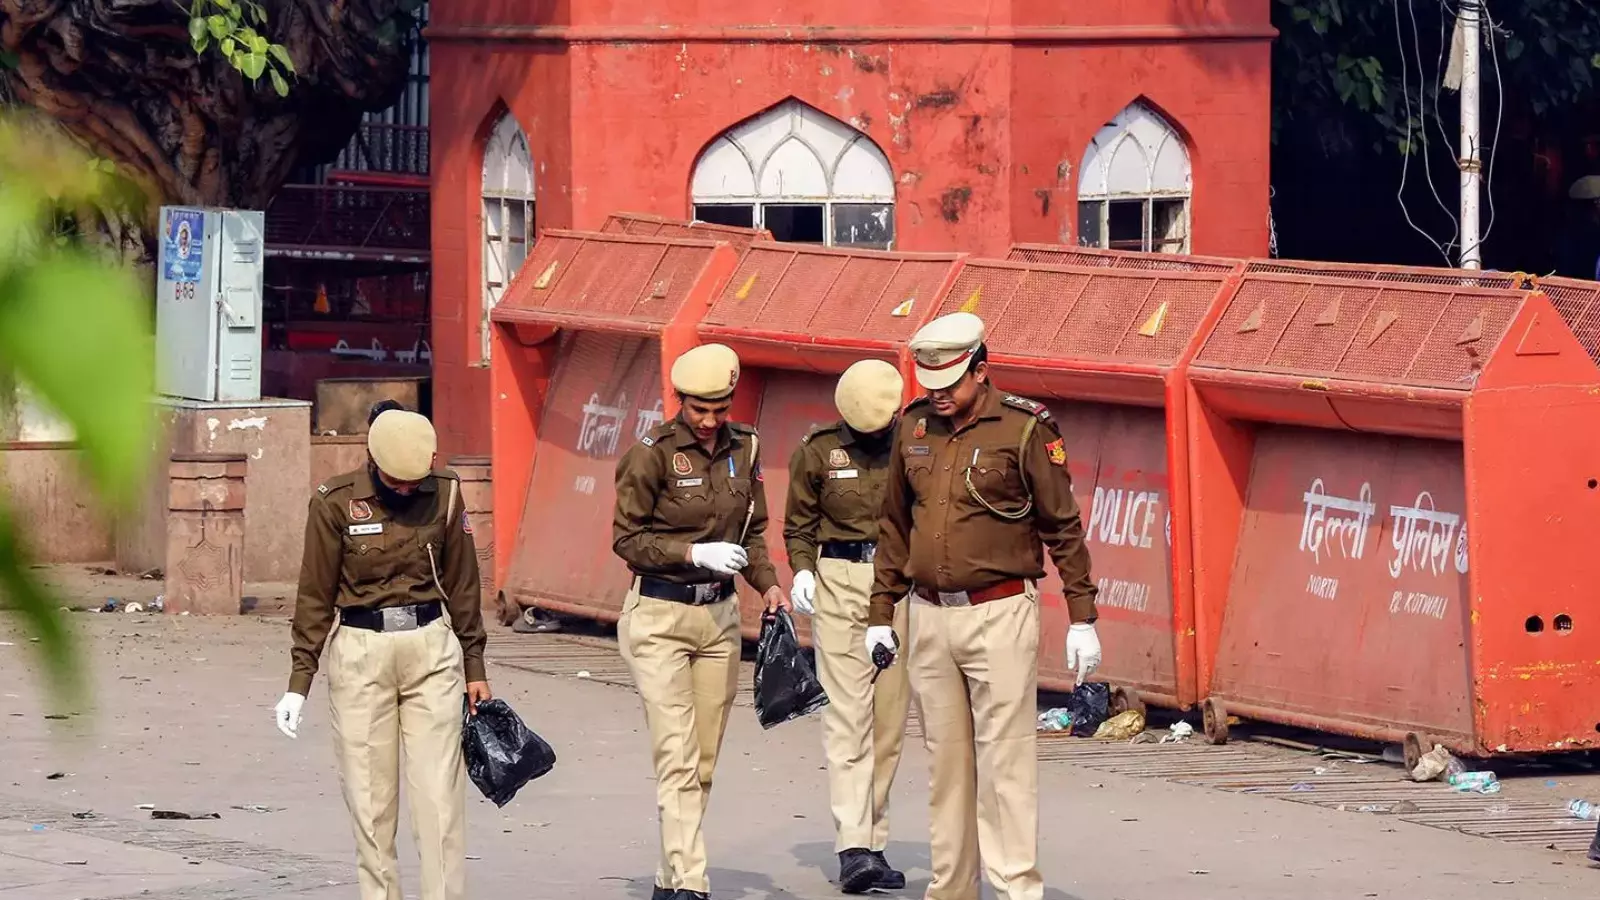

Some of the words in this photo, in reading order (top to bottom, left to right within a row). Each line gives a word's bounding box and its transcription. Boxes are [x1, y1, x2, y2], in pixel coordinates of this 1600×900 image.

[1086, 486, 1159, 548] POLICE
[1299, 478, 1376, 565] दिल्ली
[1389, 491, 1460, 579] पुलिस
[1306, 574, 1339, 600] NORTH
[1404, 592, 1448, 620] KOTWALI
